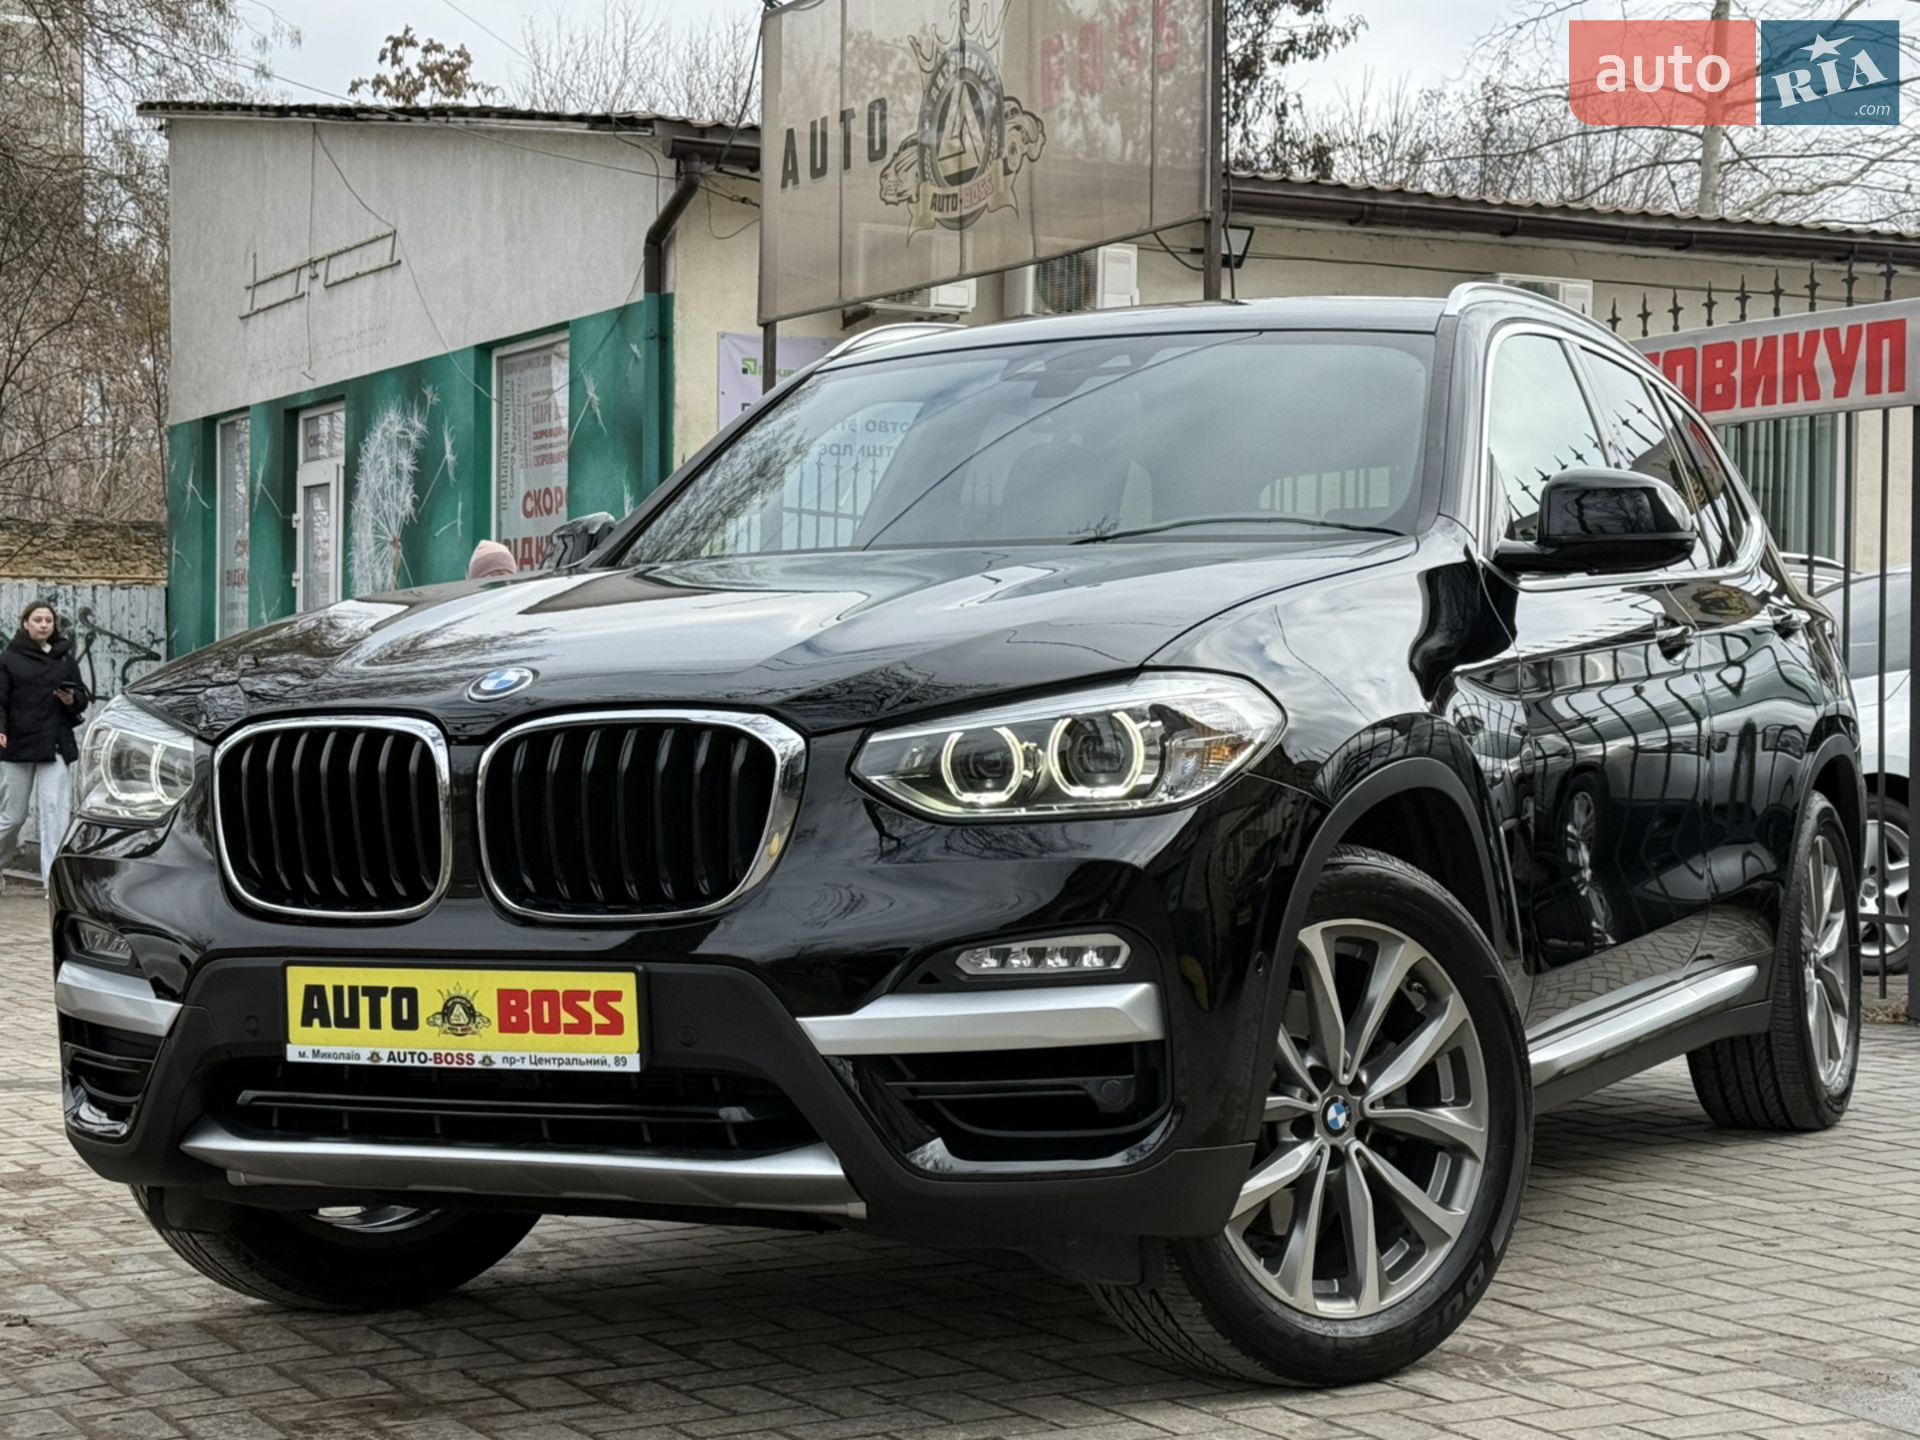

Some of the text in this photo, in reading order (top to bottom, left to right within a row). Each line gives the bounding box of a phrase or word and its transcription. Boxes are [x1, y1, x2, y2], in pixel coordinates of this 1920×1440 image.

[780, 96, 888, 190] AUTO
[1644, 318, 1907, 413] ОВИКУП
[300, 984, 625, 1036] AUTO BOSS
[311, 1048, 361, 1061] Миколаїв
[387, 1051, 476, 1066] AUTO-BOSS
[502, 1054, 628, 1068] пр-т Центральний, 89
